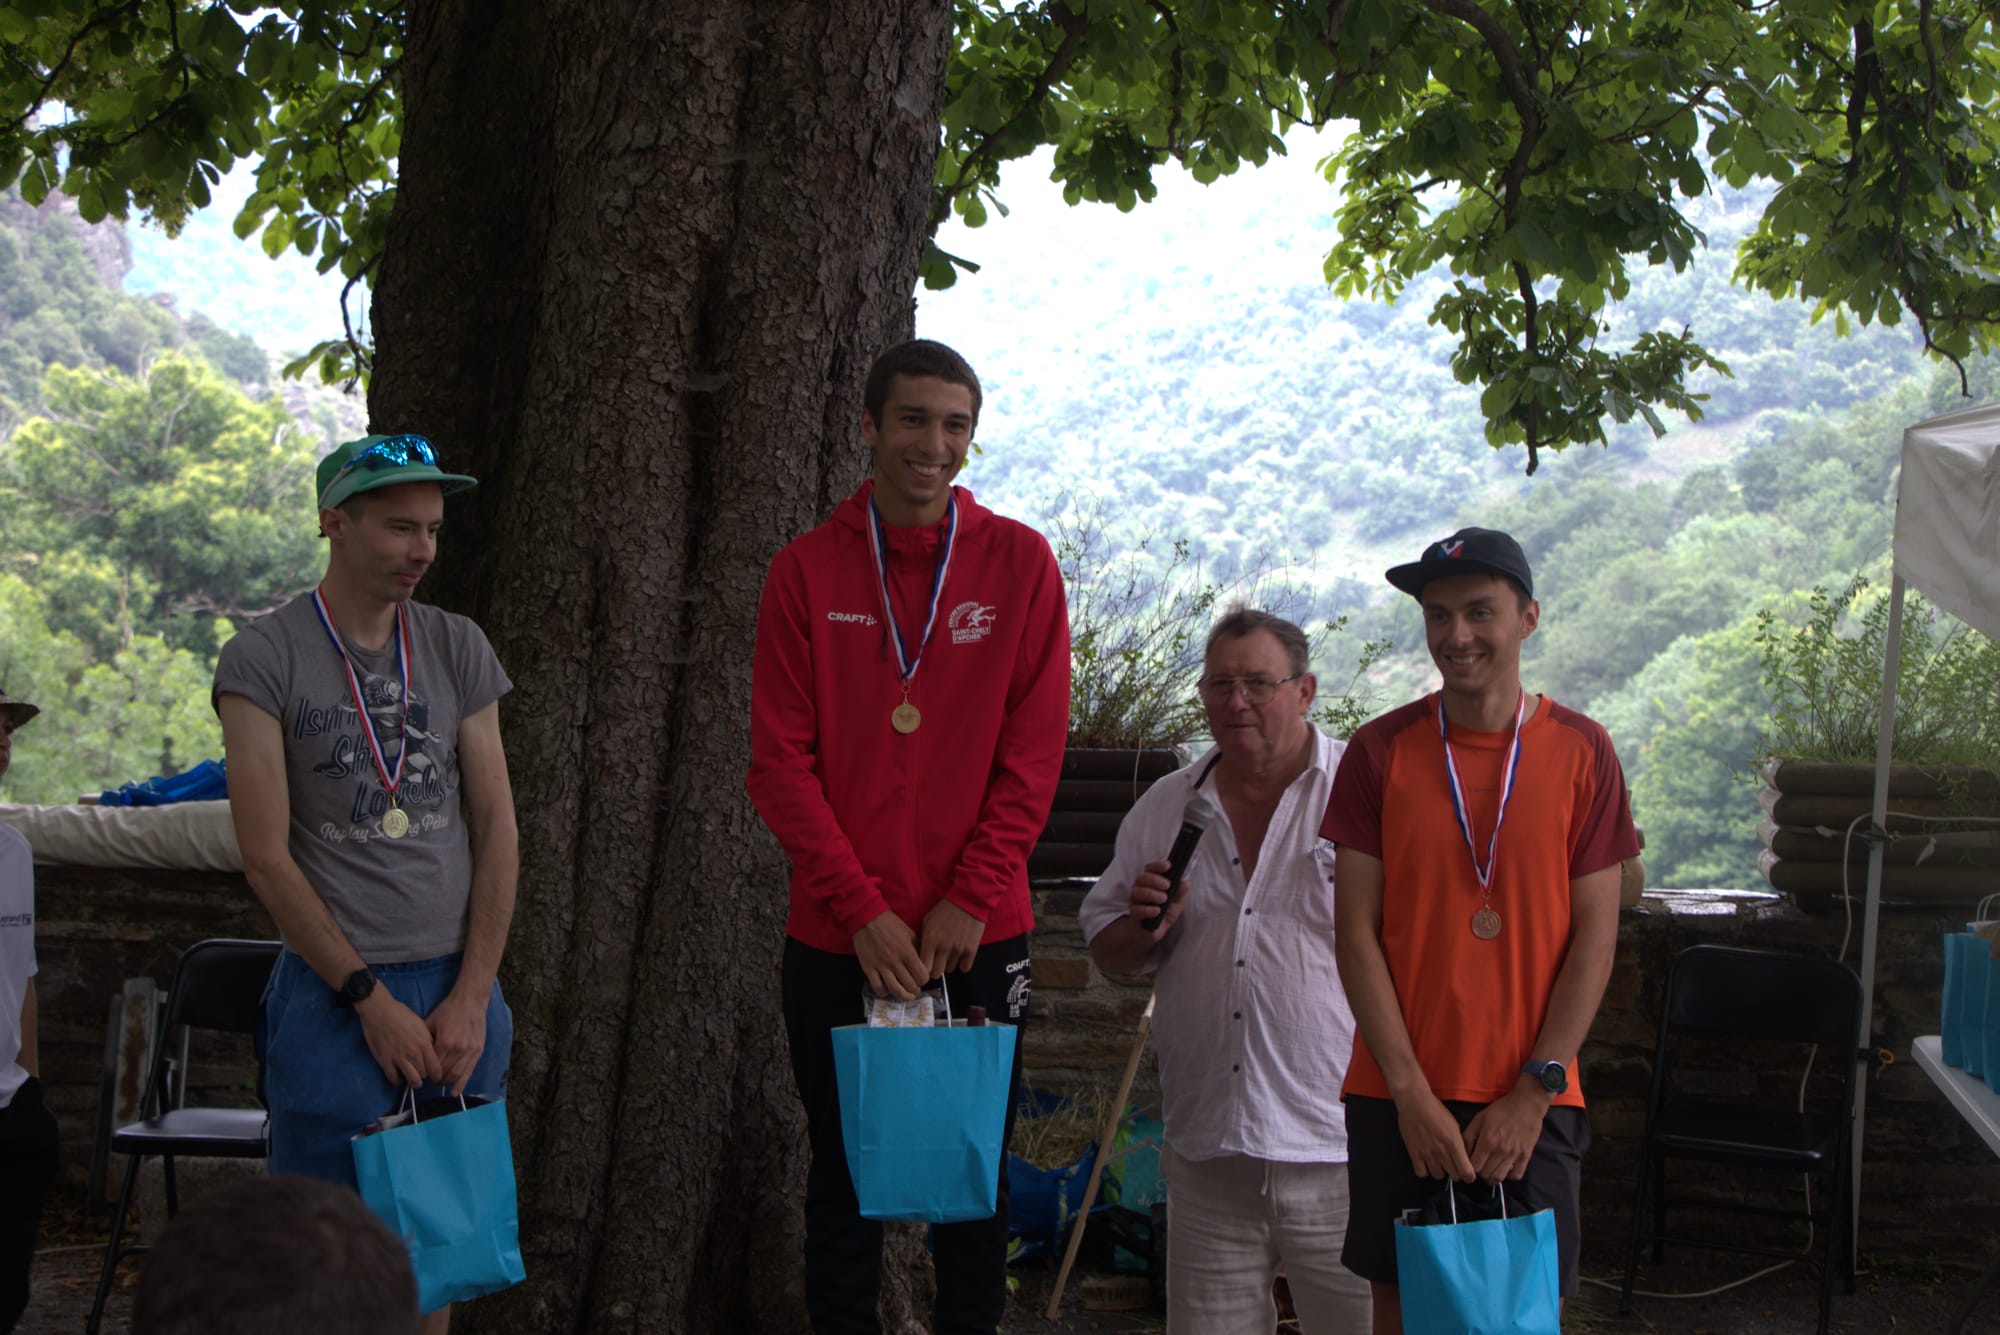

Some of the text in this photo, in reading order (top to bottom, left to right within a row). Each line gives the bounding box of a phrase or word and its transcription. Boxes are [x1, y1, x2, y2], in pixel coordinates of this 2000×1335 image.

[827, 611, 866, 624] CRAFT
[326, 733, 378, 779] Sh
[320, 821, 369, 844] Replay
[1005, 958, 1030, 974] CRAFT
